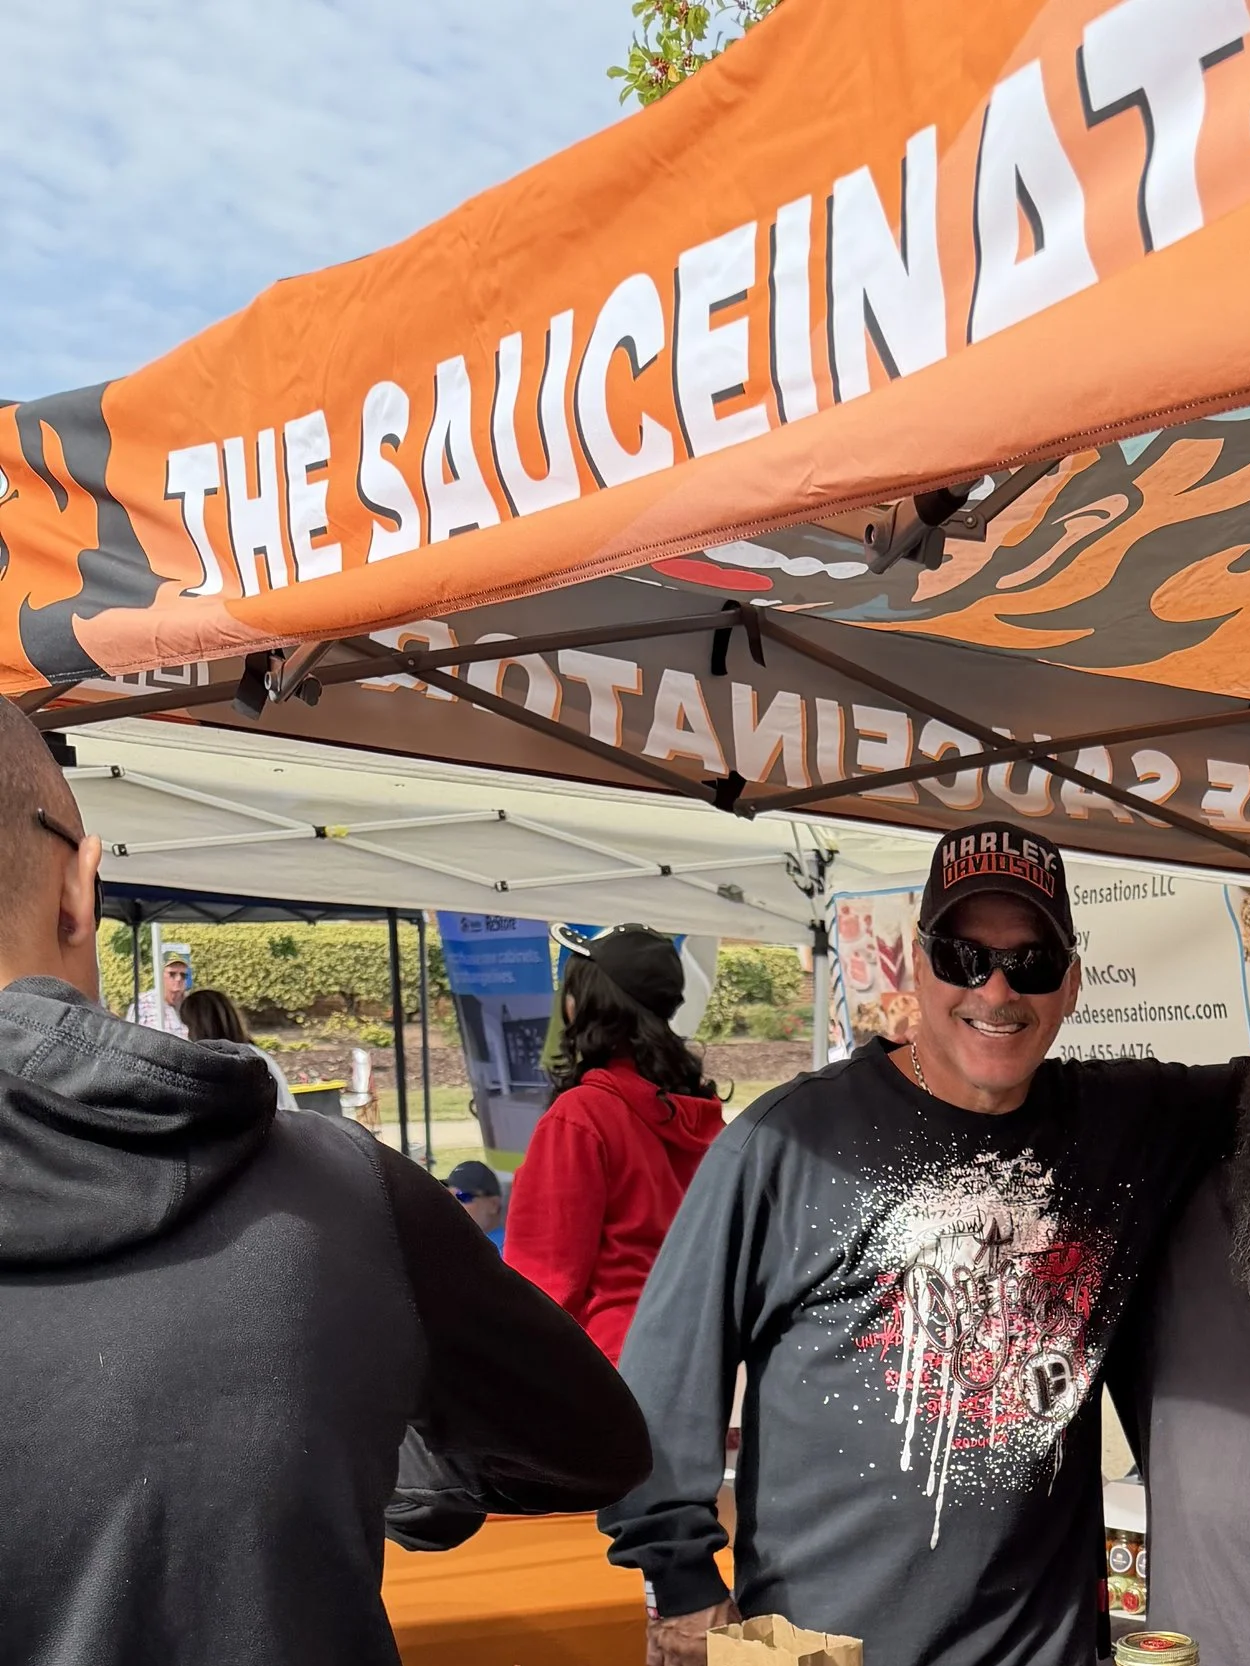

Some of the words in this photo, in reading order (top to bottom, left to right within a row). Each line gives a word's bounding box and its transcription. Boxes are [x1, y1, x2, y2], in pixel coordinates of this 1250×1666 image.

[164, 408, 342, 598] THE
[944, 852, 1054, 896] DAVIDSON
[1073, 880, 1148, 906] Sensations
[1152, 875, 1176, 898] LLC
[1085, 964, 1136, 987] McCoy
